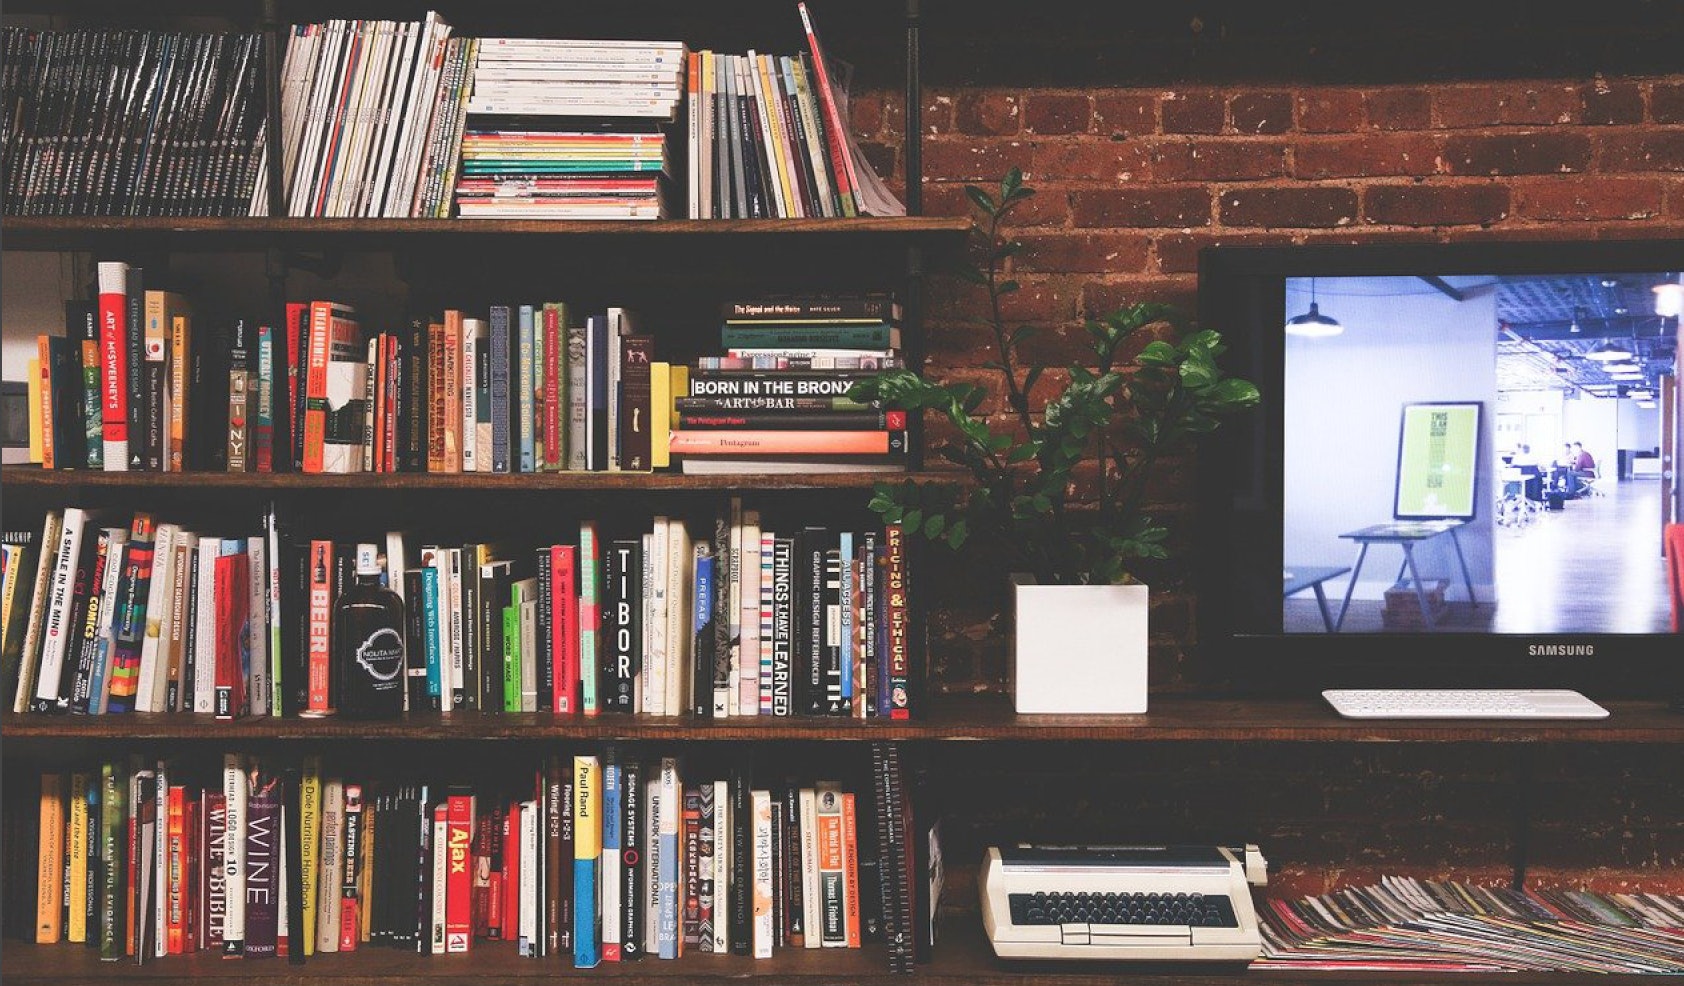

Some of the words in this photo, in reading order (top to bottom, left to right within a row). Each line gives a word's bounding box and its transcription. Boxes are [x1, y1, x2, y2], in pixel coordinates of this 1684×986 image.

[106, 311, 115, 330] ART
[734, 305, 746, 314] The
[746, 305, 763, 316] Signal
[764, 306, 774, 314] and
[776, 306, 784, 314] the
[312, 307, 326, 368] FREAKONOMICS
[260, 340, 271, 380] UTTERLY
[446, 334, 456, 397] UNMARKETING
[694, 381, 740, 394] BORN
[744, 381, 760, 394] IN
[762, 381, 793, 394] THE
[797, 381, 854, 394] BRONX
[722, 398, 750, 409] ART
[766, 398, 794, 408] BAR
[695, 417, 726, 426] Pentagram
[728, 418, 746, 426] Papers
[720, 438, 760, 448] Pentagram
[66, 528, 74, 536] A
[672, 539, 680, 548] The
[60, 538, 72, 570] SMILE
[110, 552, 120, 573] cool
[671, 552, 680, 567] Visual
[890, 530, 902, 589] PRICING
[59, 573, 68, 585] IN
[92, 556, 106, 596] MAKING
[128, 566, 139, 592] Designing
[175, 552, 184, 588] INFORMATION
[670, 570, 680, 590] Display
[775, 550, 789, 600] THINGS
[812, 551, 821, 592] GRAPHIC
[842, 560, 851, 582] ALL
[54, 588, 65, 606] THE
[104, 576, 116, 616] cocktails
[424, 572, 434, 608] Designing
[698, 578, 706, 620] PREFAB
[890, 594, 904, 608] &
[84, 596, 100, 639] COMICS
[174, 588, 182, 620] DASHBOARD
[618, 550, 631, 679] TIBOR
[812, 592, 821, 626] DESIGN
[842, 582, 850, 626] ACCESS
[50, 608, 62, 637] MIND
[173, 621, 181, 641] DESIGN
[310, 590, 327, 652] BEER
[426, 613, 434, 627] Web
[779, 612, 788, 640] HAVE
[426, 630, 436, 665] Interfaces
[892, 612, 904, 672] ETHICAL
[1528, 644, 1594, 656] SAMSUNG
[812, 627, 820, 685] REFERENCED
[73, 672, 83, 702] McCLOUD
[774, 641, 789, 716] LEARNED
[580, 767, 590, 789] Paul
[664, 758, 676, 786] Zappos
[305, 786, 314, 808] Dole
[550, 784, 560, 814] Wiring
[562, 784, 572, 816] Flooring
[580, 792, 590, 817] Rand
[628, 774, 636, 808] SIGNAGE
[228, 809, 238, 832] LOGO
[324, 812, 338, 838] perfect
[550, 816, 559, 837] 1-2-3
[628, 810, 636, 847] SYSTEMS
[651, 796, 660, 836] UNIMARK
[829, 818, 838, 829] The
[210, 808, 226, 860] WINE
[302, 811, 314, 856] Nutrition
[346, 815, 356, 856] TASTING
[562, 820, 572, 840] 1-2-3
[736, 826, 744, 846] NEW
[790, 826, 798, 840] THE
[828, 830, 839, 847] World
[247, 816, 270, 904] WINE
[324, 837, 338, 866] pairings
[448, 828, 468, 874] Ajax
[736, 850, 744, 872] YORK
[791, 843, 799, 854] ART
[791, 858, 800, 866] OF
[828, 855, 840, 867] Flat
[226, 860, 237, 876] 10
[346, 858, 354, 883] BEER
[650, 838, 660, 908] INTERNATIONAL
[792, 868, 800, 882] THE
[302, 860, 312, 911] Handbook
[792, 886, 801, 907] START
[826, 876, 838, 900] Thomas
[848, 879, 856, 888] BY
[210, 876, 226, 938] BIBLE
[736, 876, 744, 925] DRAWINGS
[848, 890, 856, 916] DESIGN
[106, 894, 114, 943] EVIDENCE
[828, 906, 840, 932] Friedman
